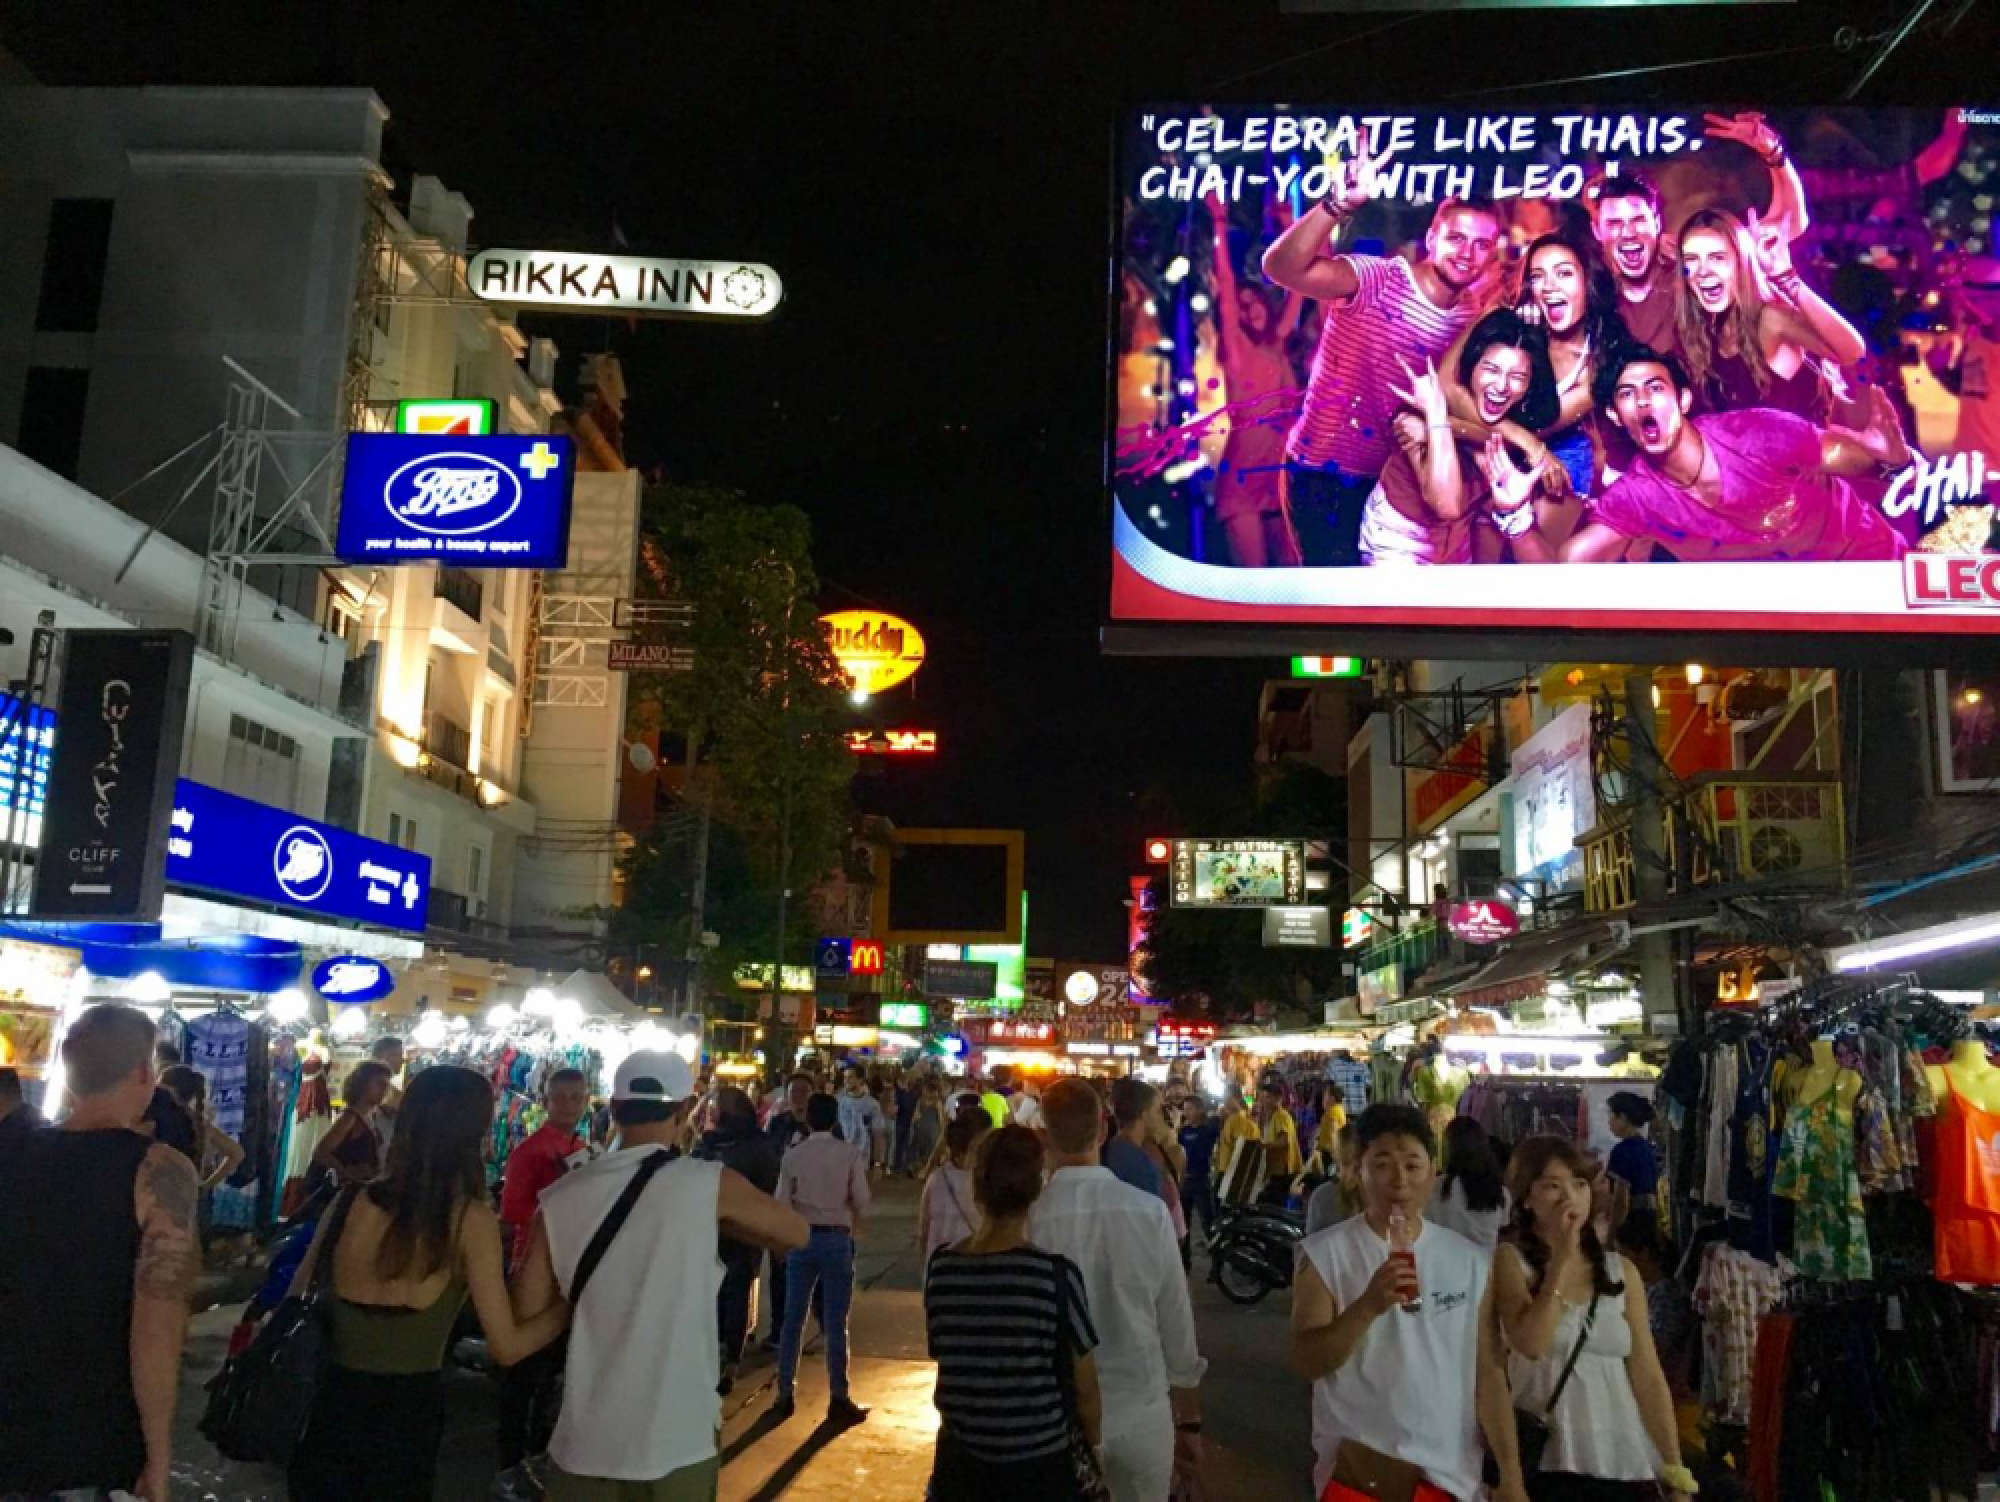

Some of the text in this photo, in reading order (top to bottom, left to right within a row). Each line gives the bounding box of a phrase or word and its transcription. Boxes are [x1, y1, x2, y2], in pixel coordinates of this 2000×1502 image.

[1141, 114, 1702, 156] "CELEBRATE LIKE THAIS.
[1362, 162, 1475, 203] WITH
[1492, 160, 1619, 201] LEO."
[481, 257, 714, 305] RIKKA INN
[611, 644, 670, 662] MILANO
[68, 847, 121, 863] CLIFF
[1101, 971, 1130, 984] OPE
